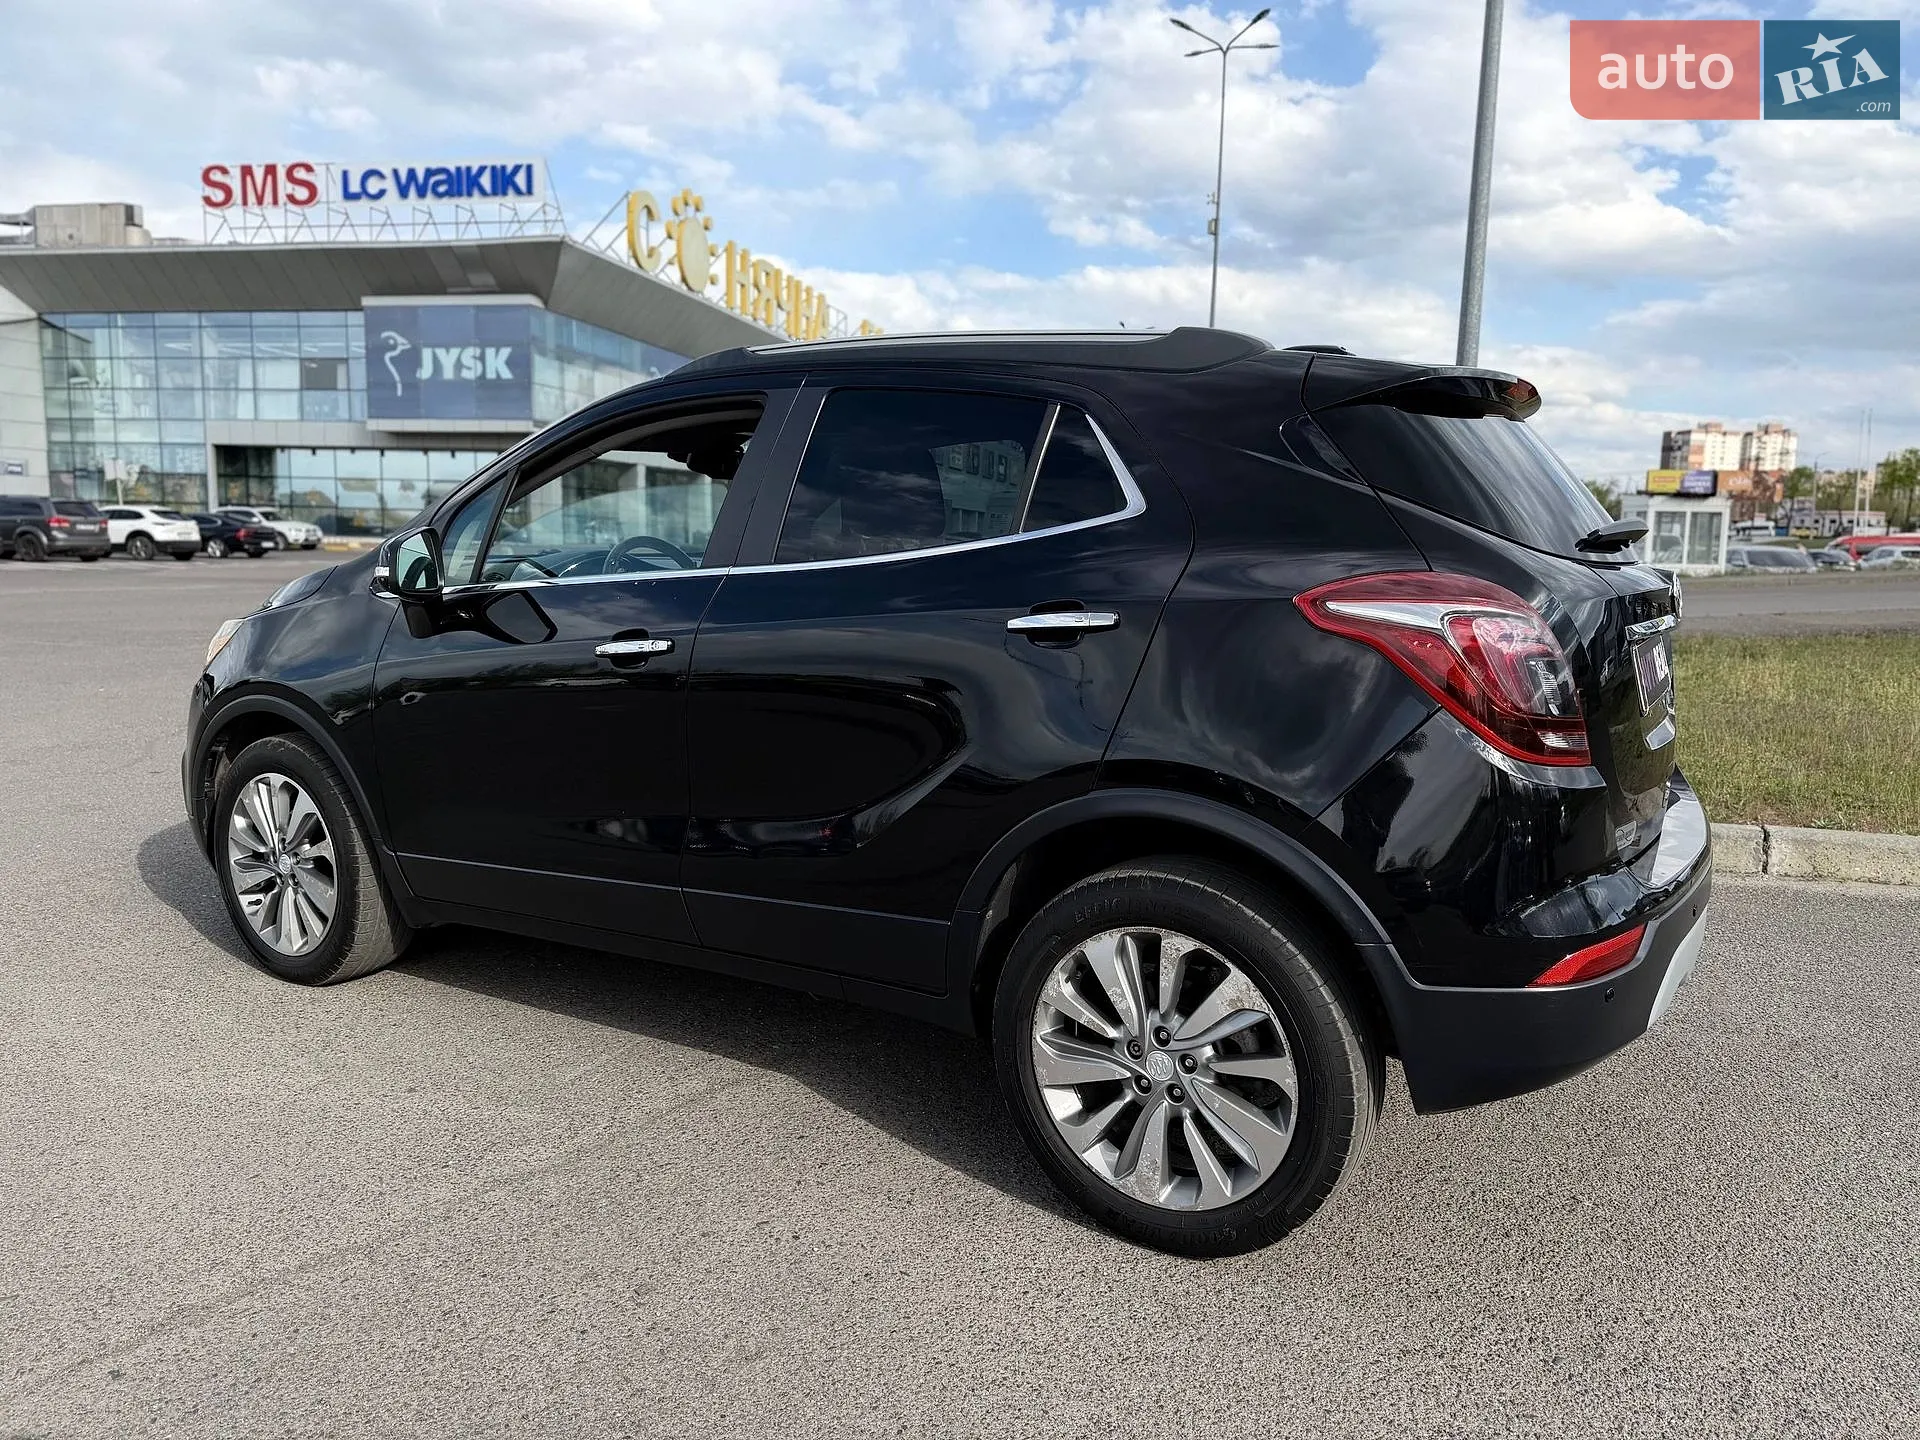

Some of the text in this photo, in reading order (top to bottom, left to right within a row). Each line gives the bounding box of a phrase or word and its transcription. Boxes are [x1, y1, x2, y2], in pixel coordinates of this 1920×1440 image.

[201, 161, 319, 209] SMS
[341, 168, 387, 201] LC
[415, 345, 514, 381] JYSK
